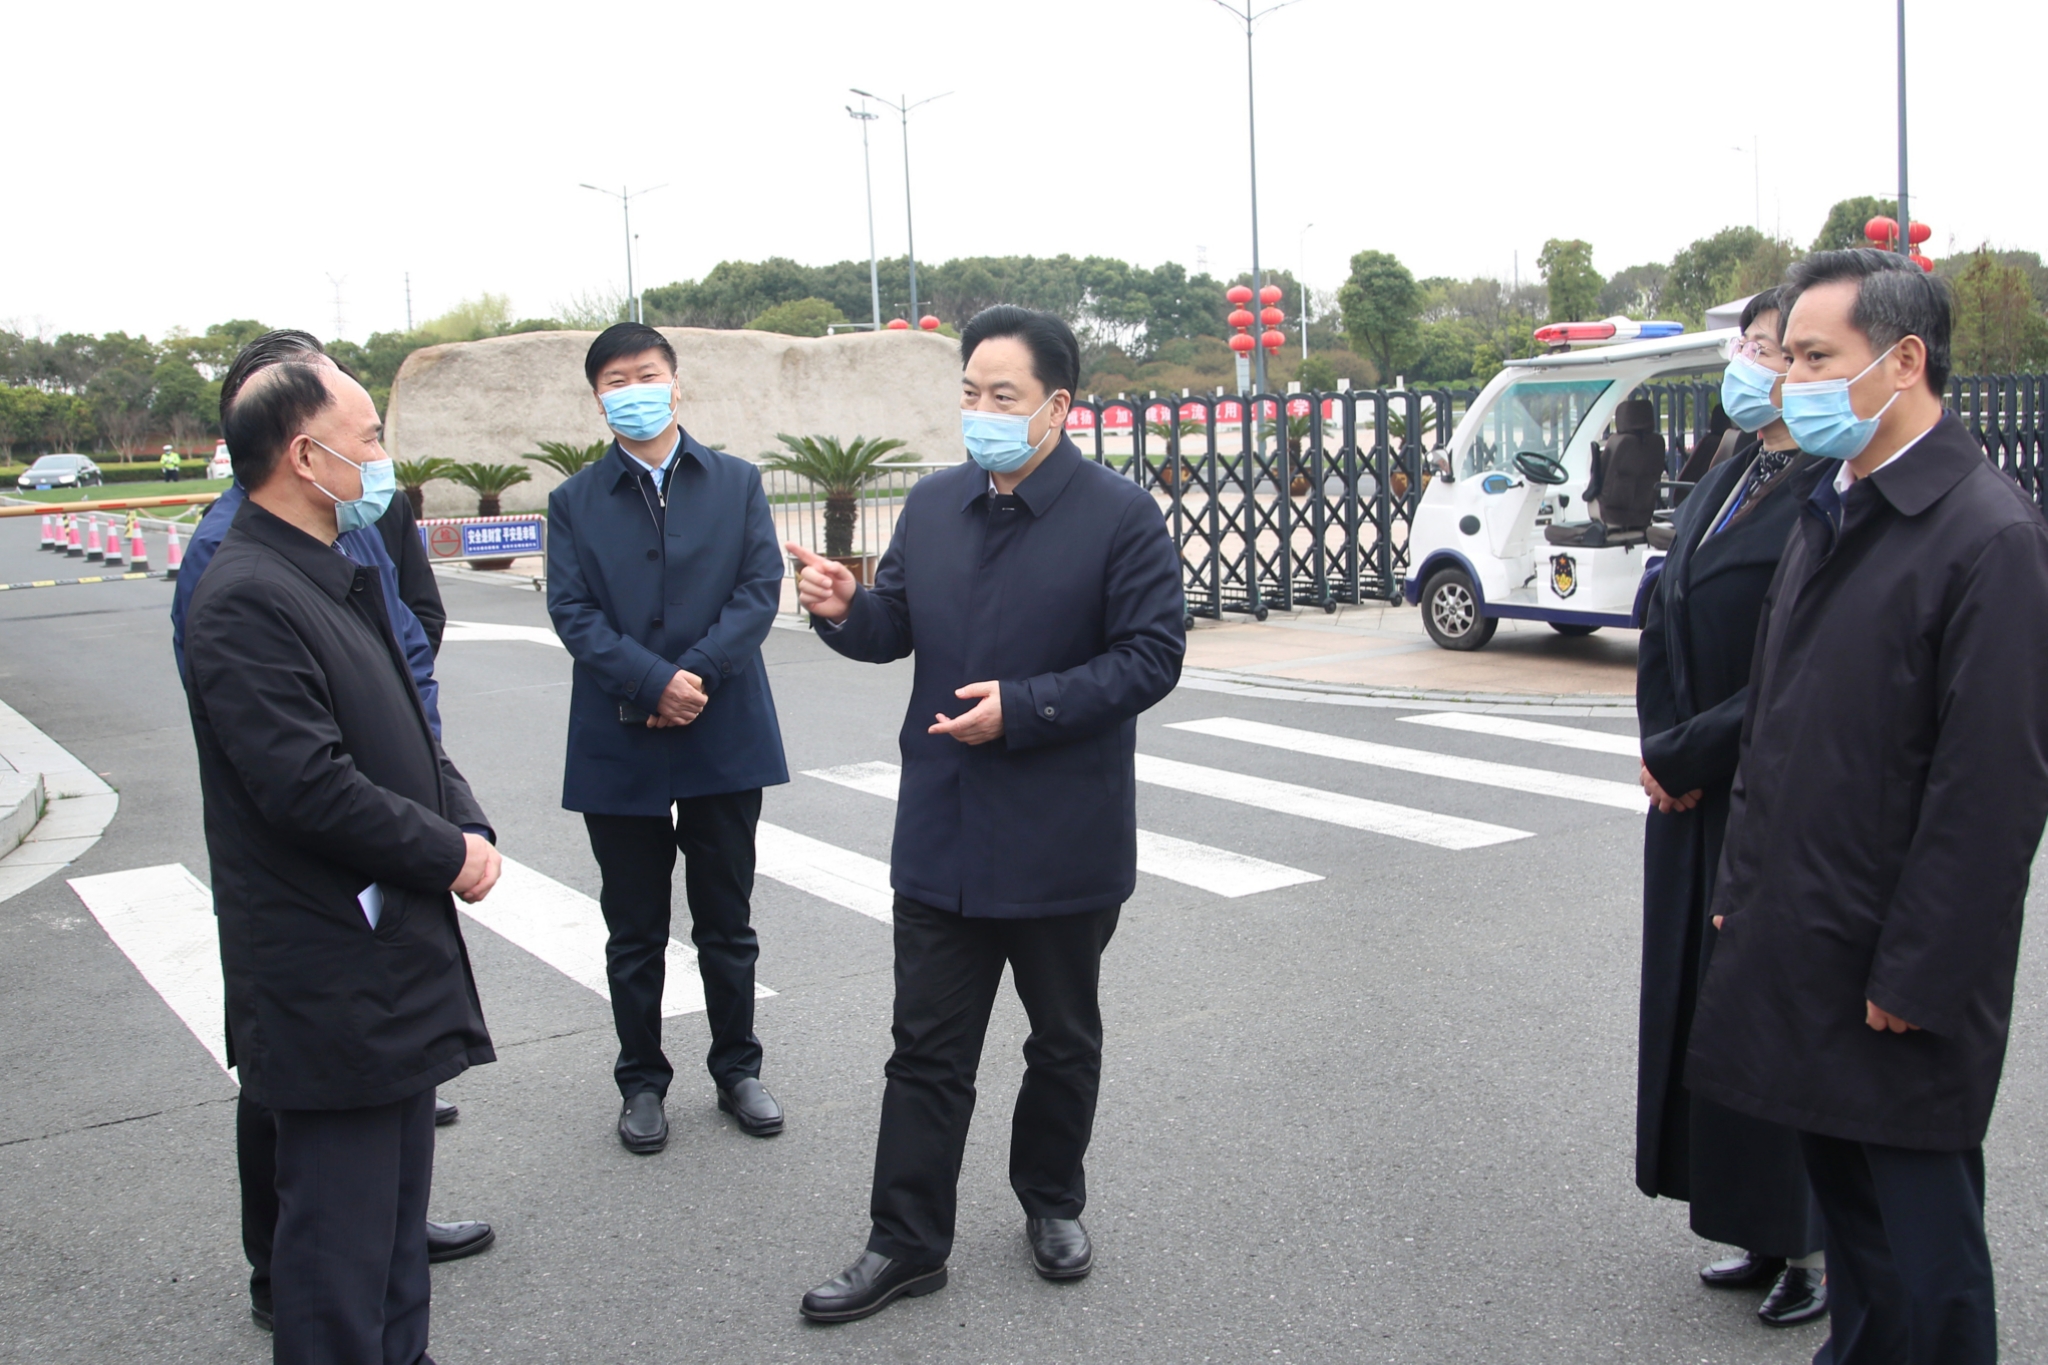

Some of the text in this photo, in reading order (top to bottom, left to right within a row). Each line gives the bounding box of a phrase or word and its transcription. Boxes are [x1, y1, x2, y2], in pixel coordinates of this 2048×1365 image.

[467, 525, 536, 544] 安全是财富 平安是幸福
